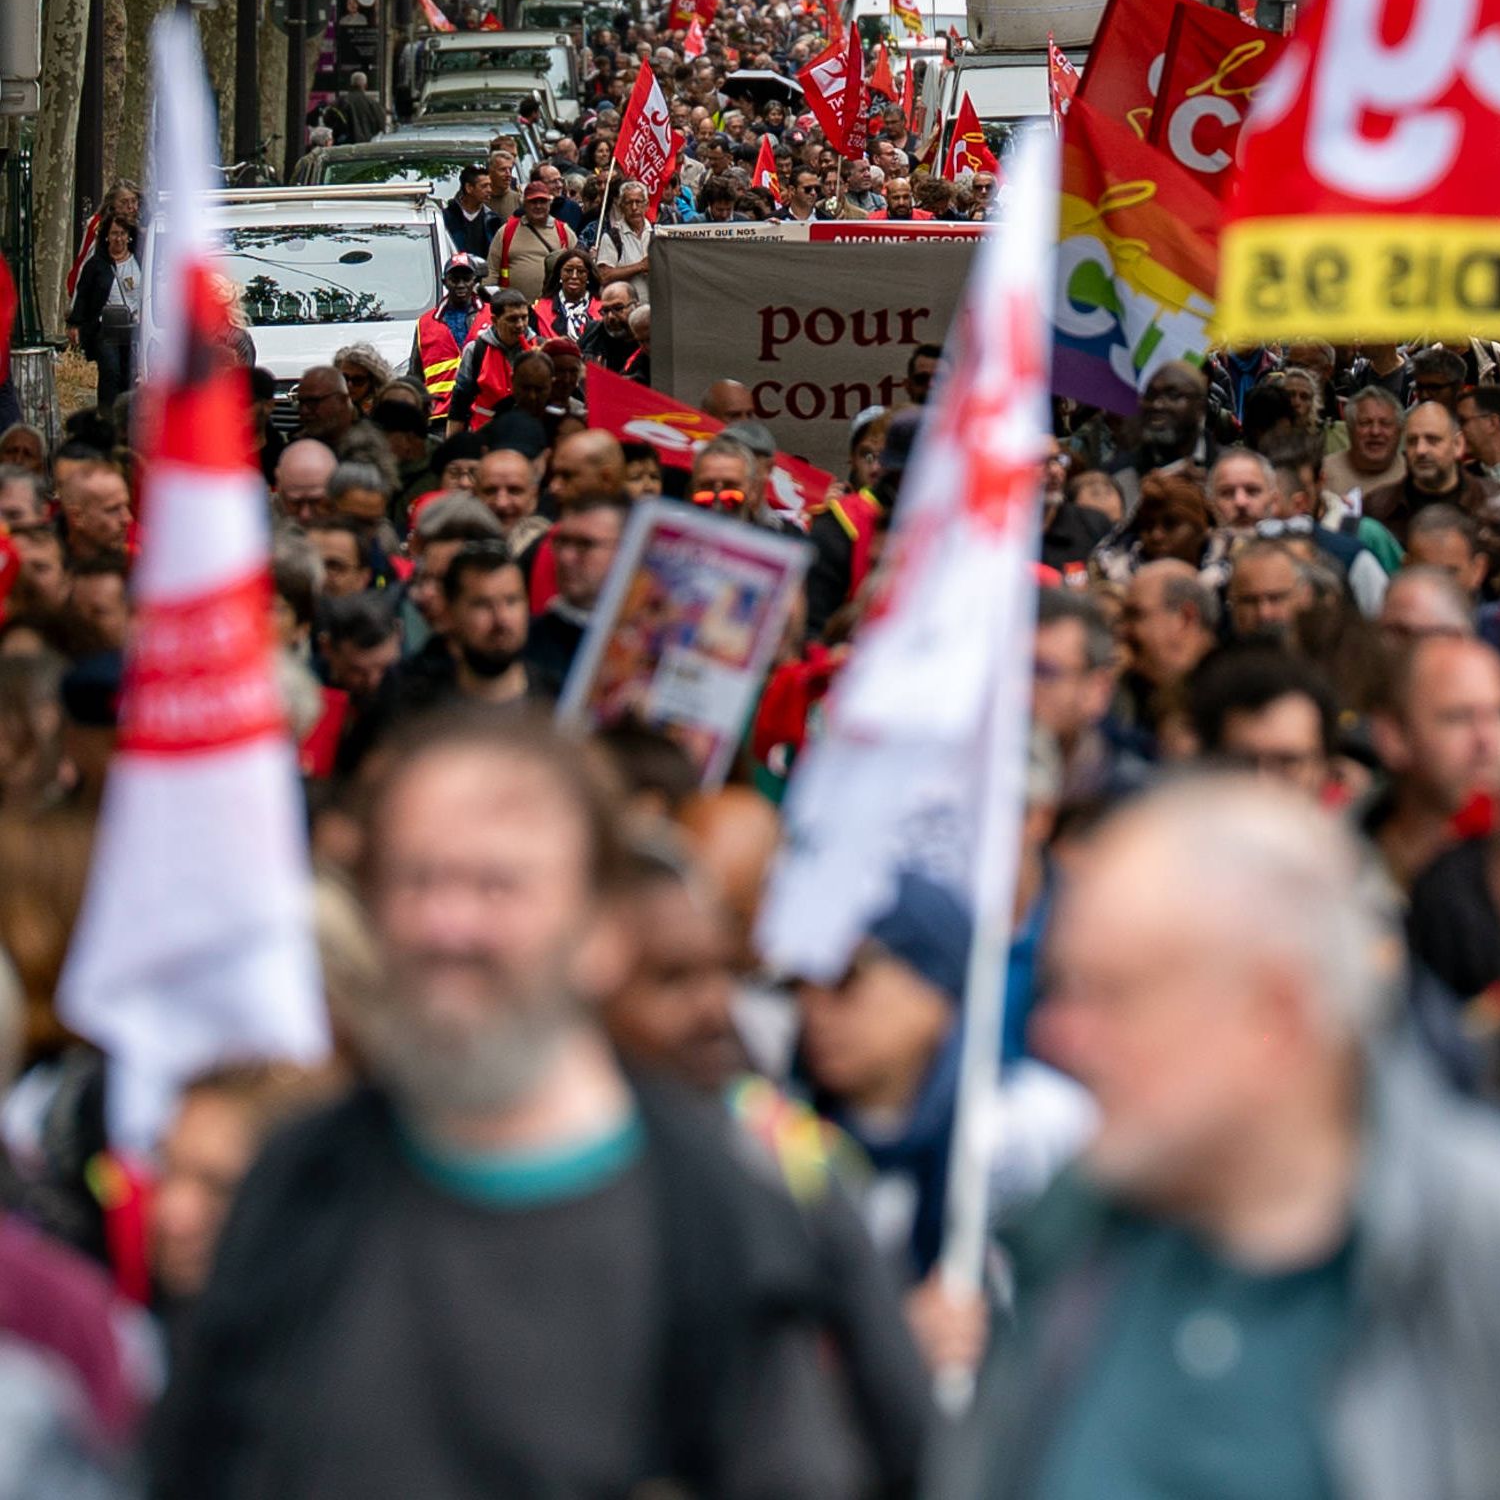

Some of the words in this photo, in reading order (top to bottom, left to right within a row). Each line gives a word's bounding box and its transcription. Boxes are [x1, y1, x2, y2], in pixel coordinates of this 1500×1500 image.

[667, 230, 711, 238] PENDANT
[715, 229, 733, 237] QUE
[737, 228, 756, 236] NOS
[757, 305, 930, 361] pour
[752, 375, 904, 420] cont
